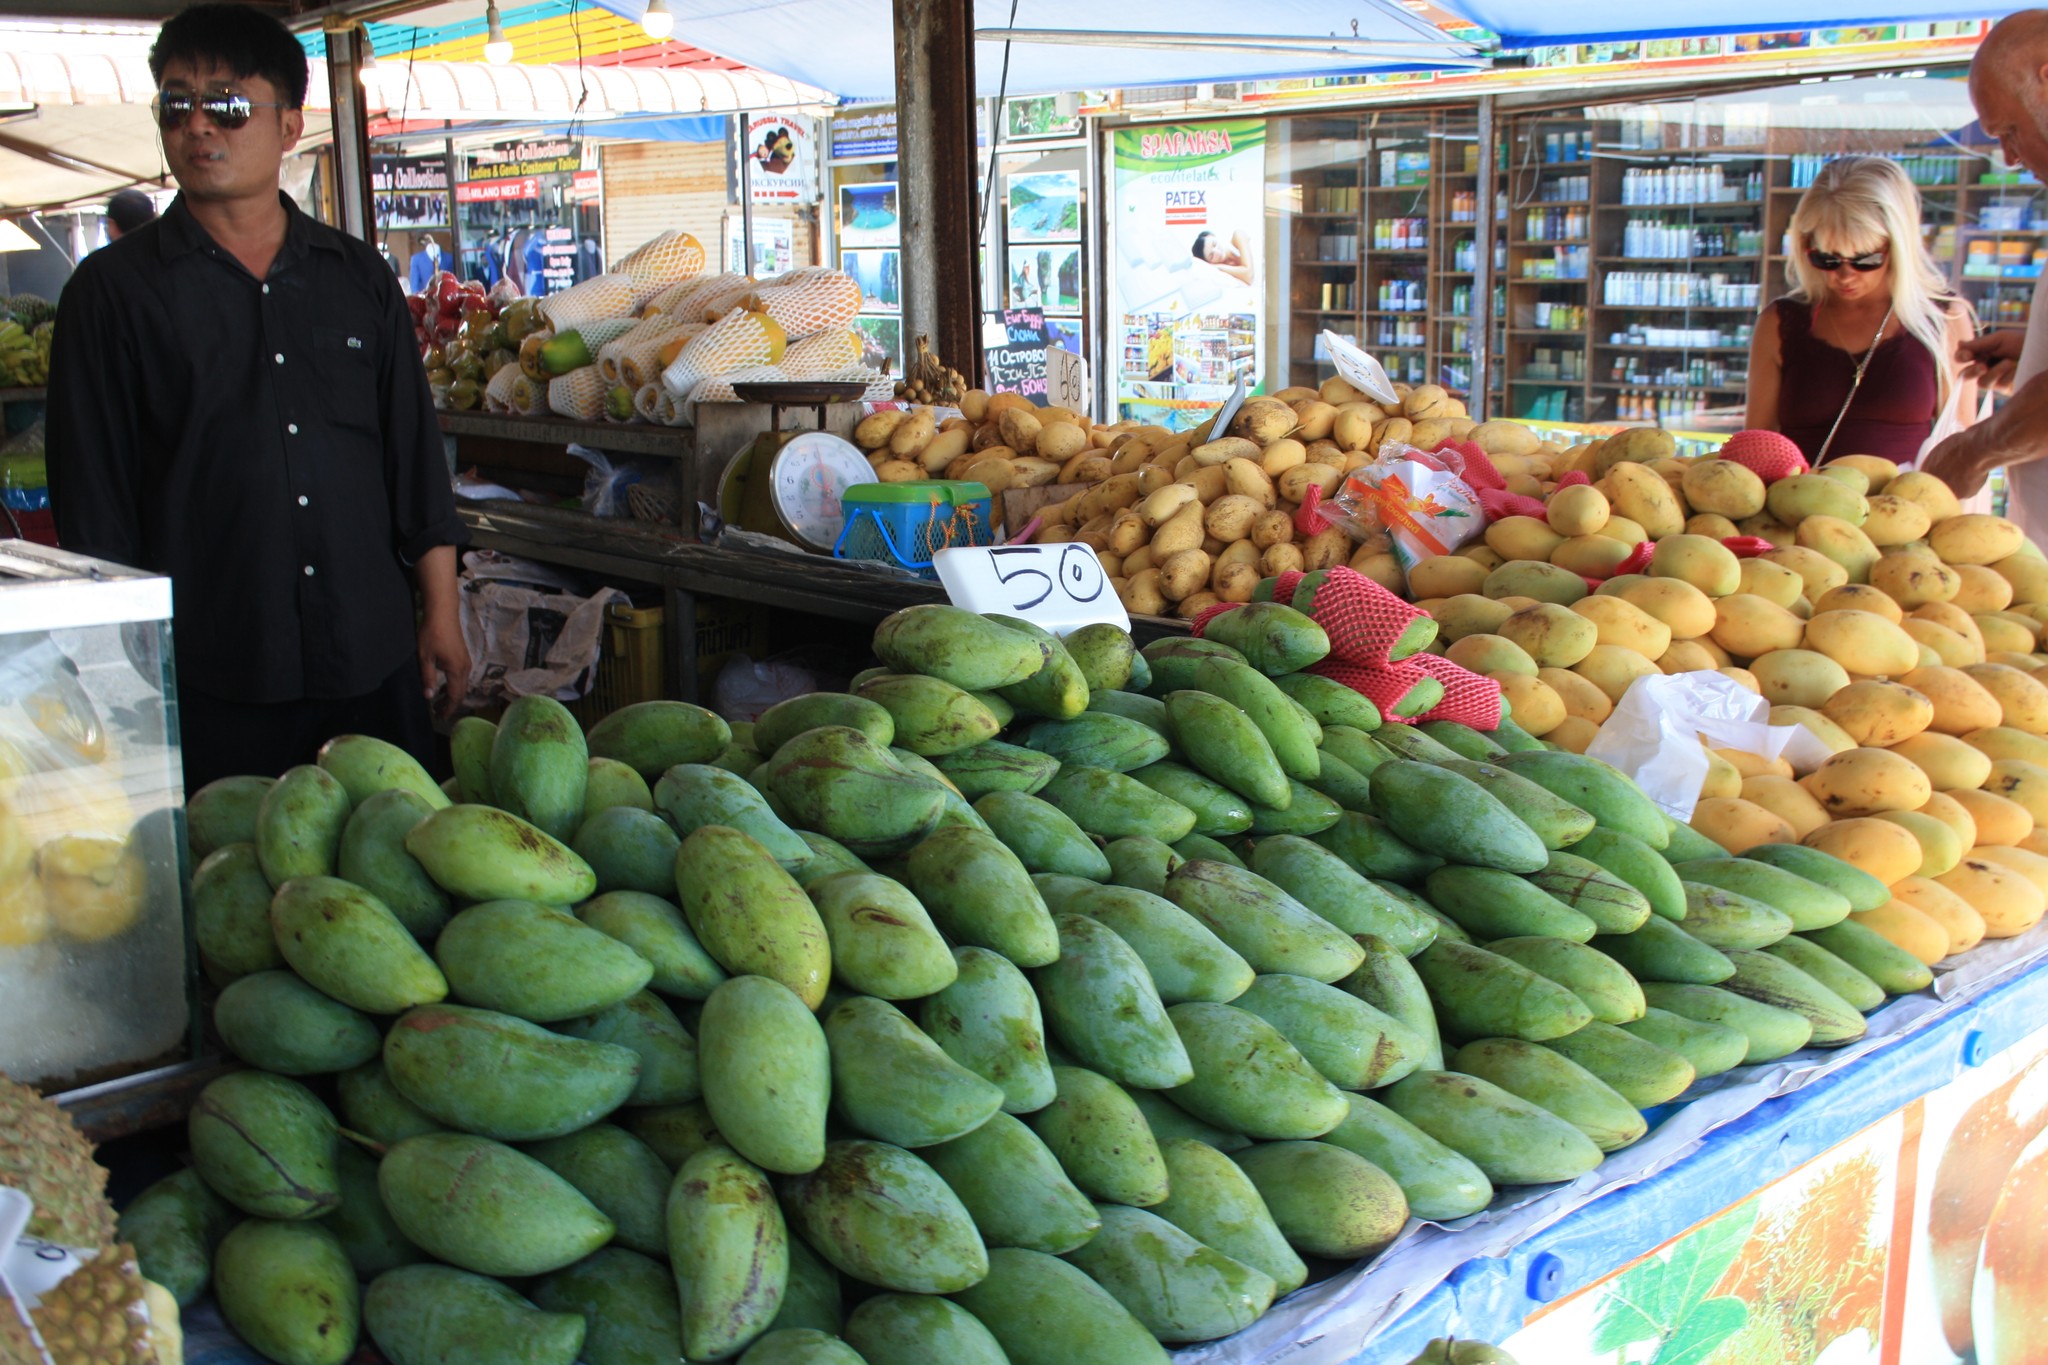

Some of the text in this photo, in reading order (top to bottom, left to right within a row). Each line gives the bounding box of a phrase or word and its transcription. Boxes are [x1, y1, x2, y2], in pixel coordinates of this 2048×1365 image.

[395, 167, 448, 189] Collection
[469, 167, 491, 180] Ladies
[557, 157, 580, 171] Tailor
[470, 186, 499, 199] MILANO
[501, 184, 520, 197] NEXT
[1165, 190, 1206, 206] PATEX
[787, 476, 794, 485] 6
[987, 544, 1104, 611] 50
